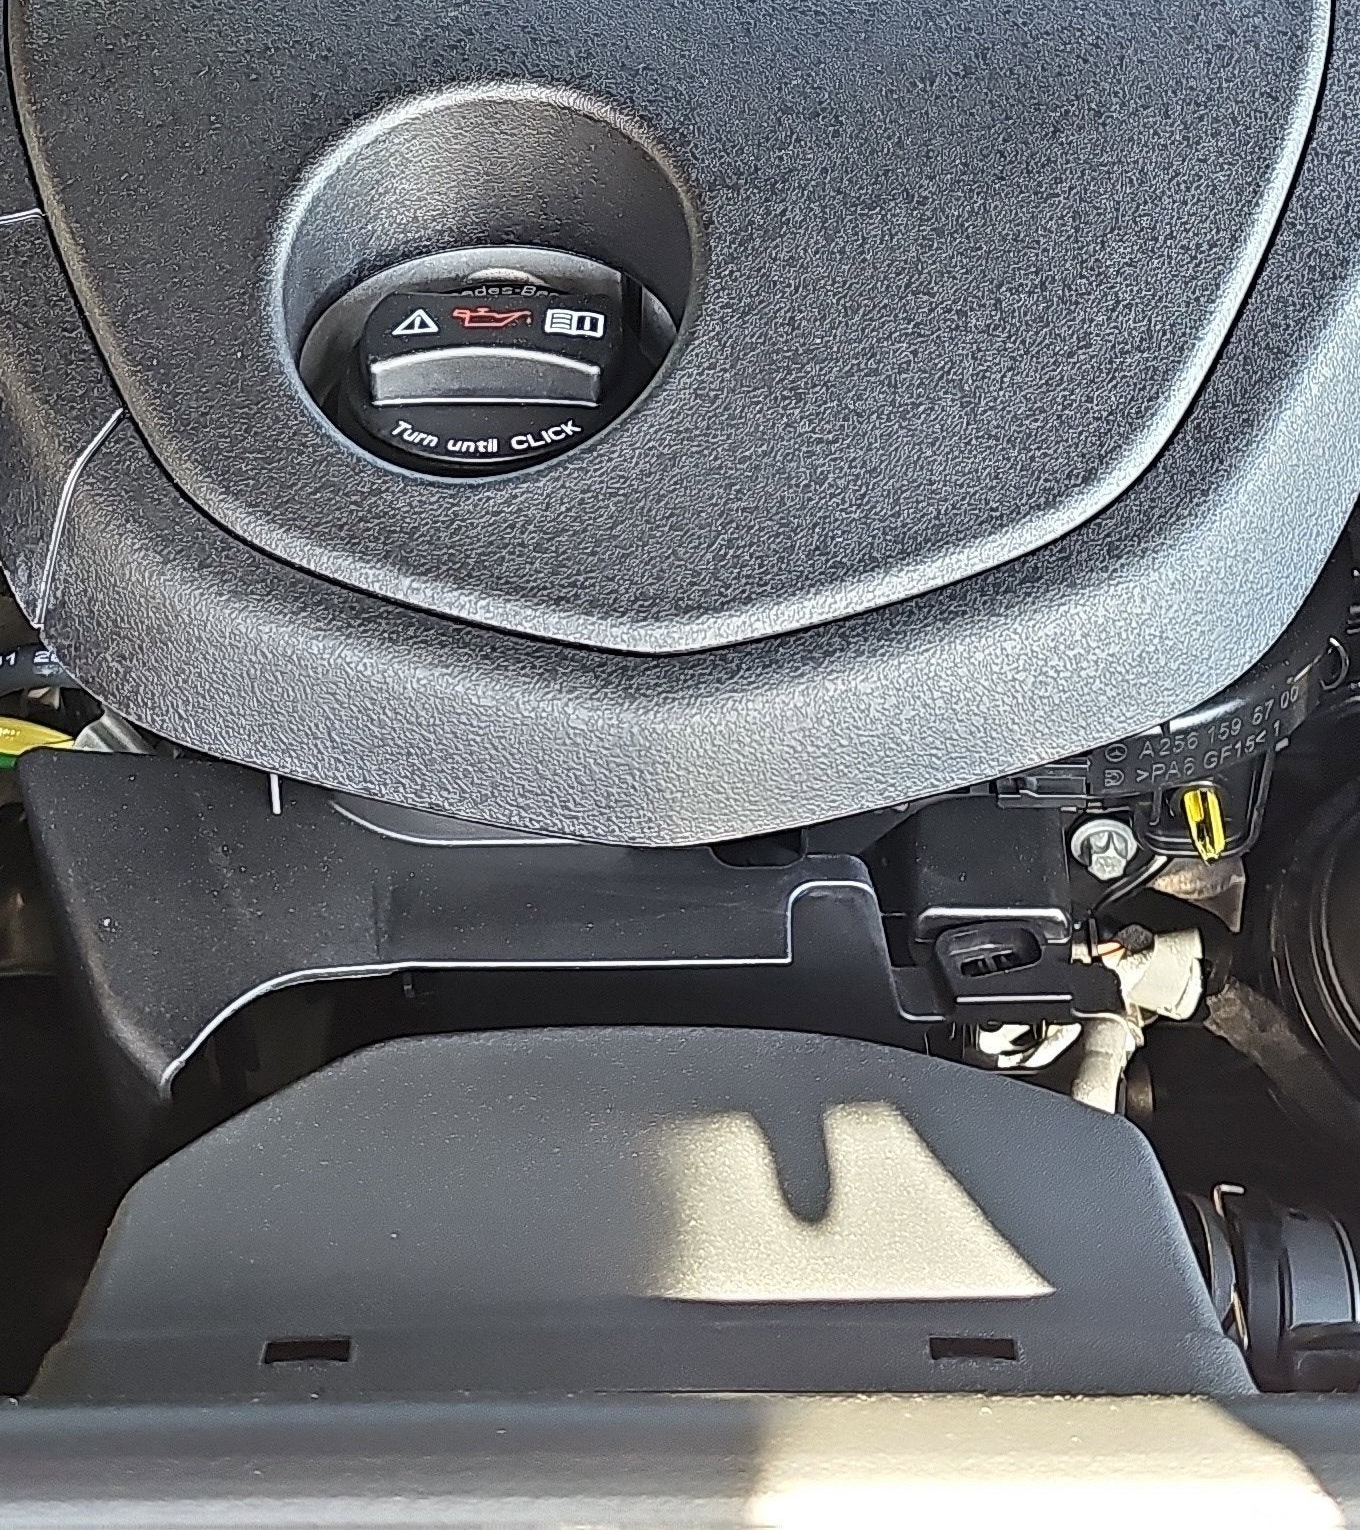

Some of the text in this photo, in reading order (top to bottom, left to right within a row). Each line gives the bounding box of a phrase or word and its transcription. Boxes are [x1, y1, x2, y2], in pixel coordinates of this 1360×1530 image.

[391, 419, 582, 453] Turn until CLICK
[1207, 717, 1243, 745] 159
[1251, 698, 1275, 726] 67
[1279, 685, 1300, 710] 00
